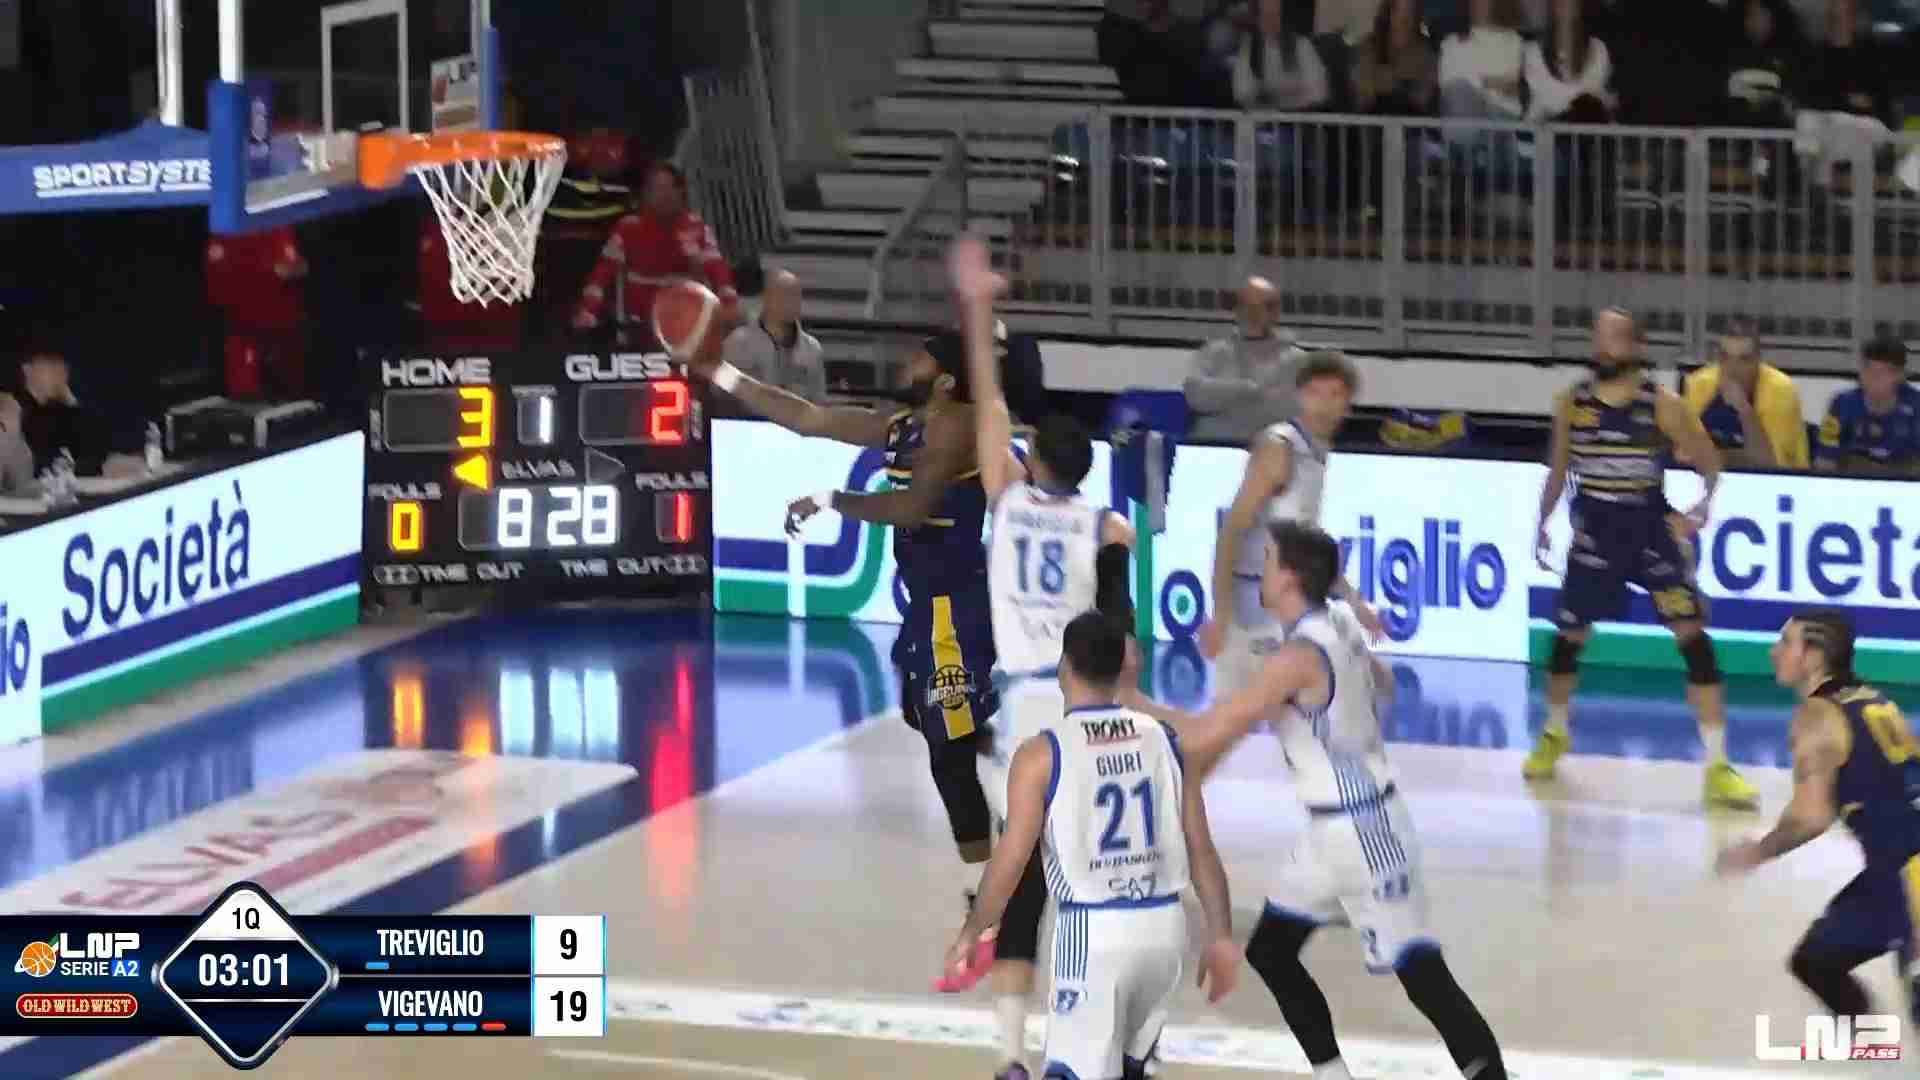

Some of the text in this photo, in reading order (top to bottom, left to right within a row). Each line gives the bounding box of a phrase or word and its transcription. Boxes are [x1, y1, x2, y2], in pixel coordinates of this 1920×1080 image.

[381, 357, 491, 386] HOME
[565, 352, 688, 381] GUES
[457, 387, 494, 448] 3
[539, 396, 551, 444] 1
[651, 381, 687, 442] 2
[61, 479, 251, 640] Società
[1014, 535, 1065, 594] 18
[1096, 751, 1143, 776] GIURI
[1095, 777, 1155, 852] 21
